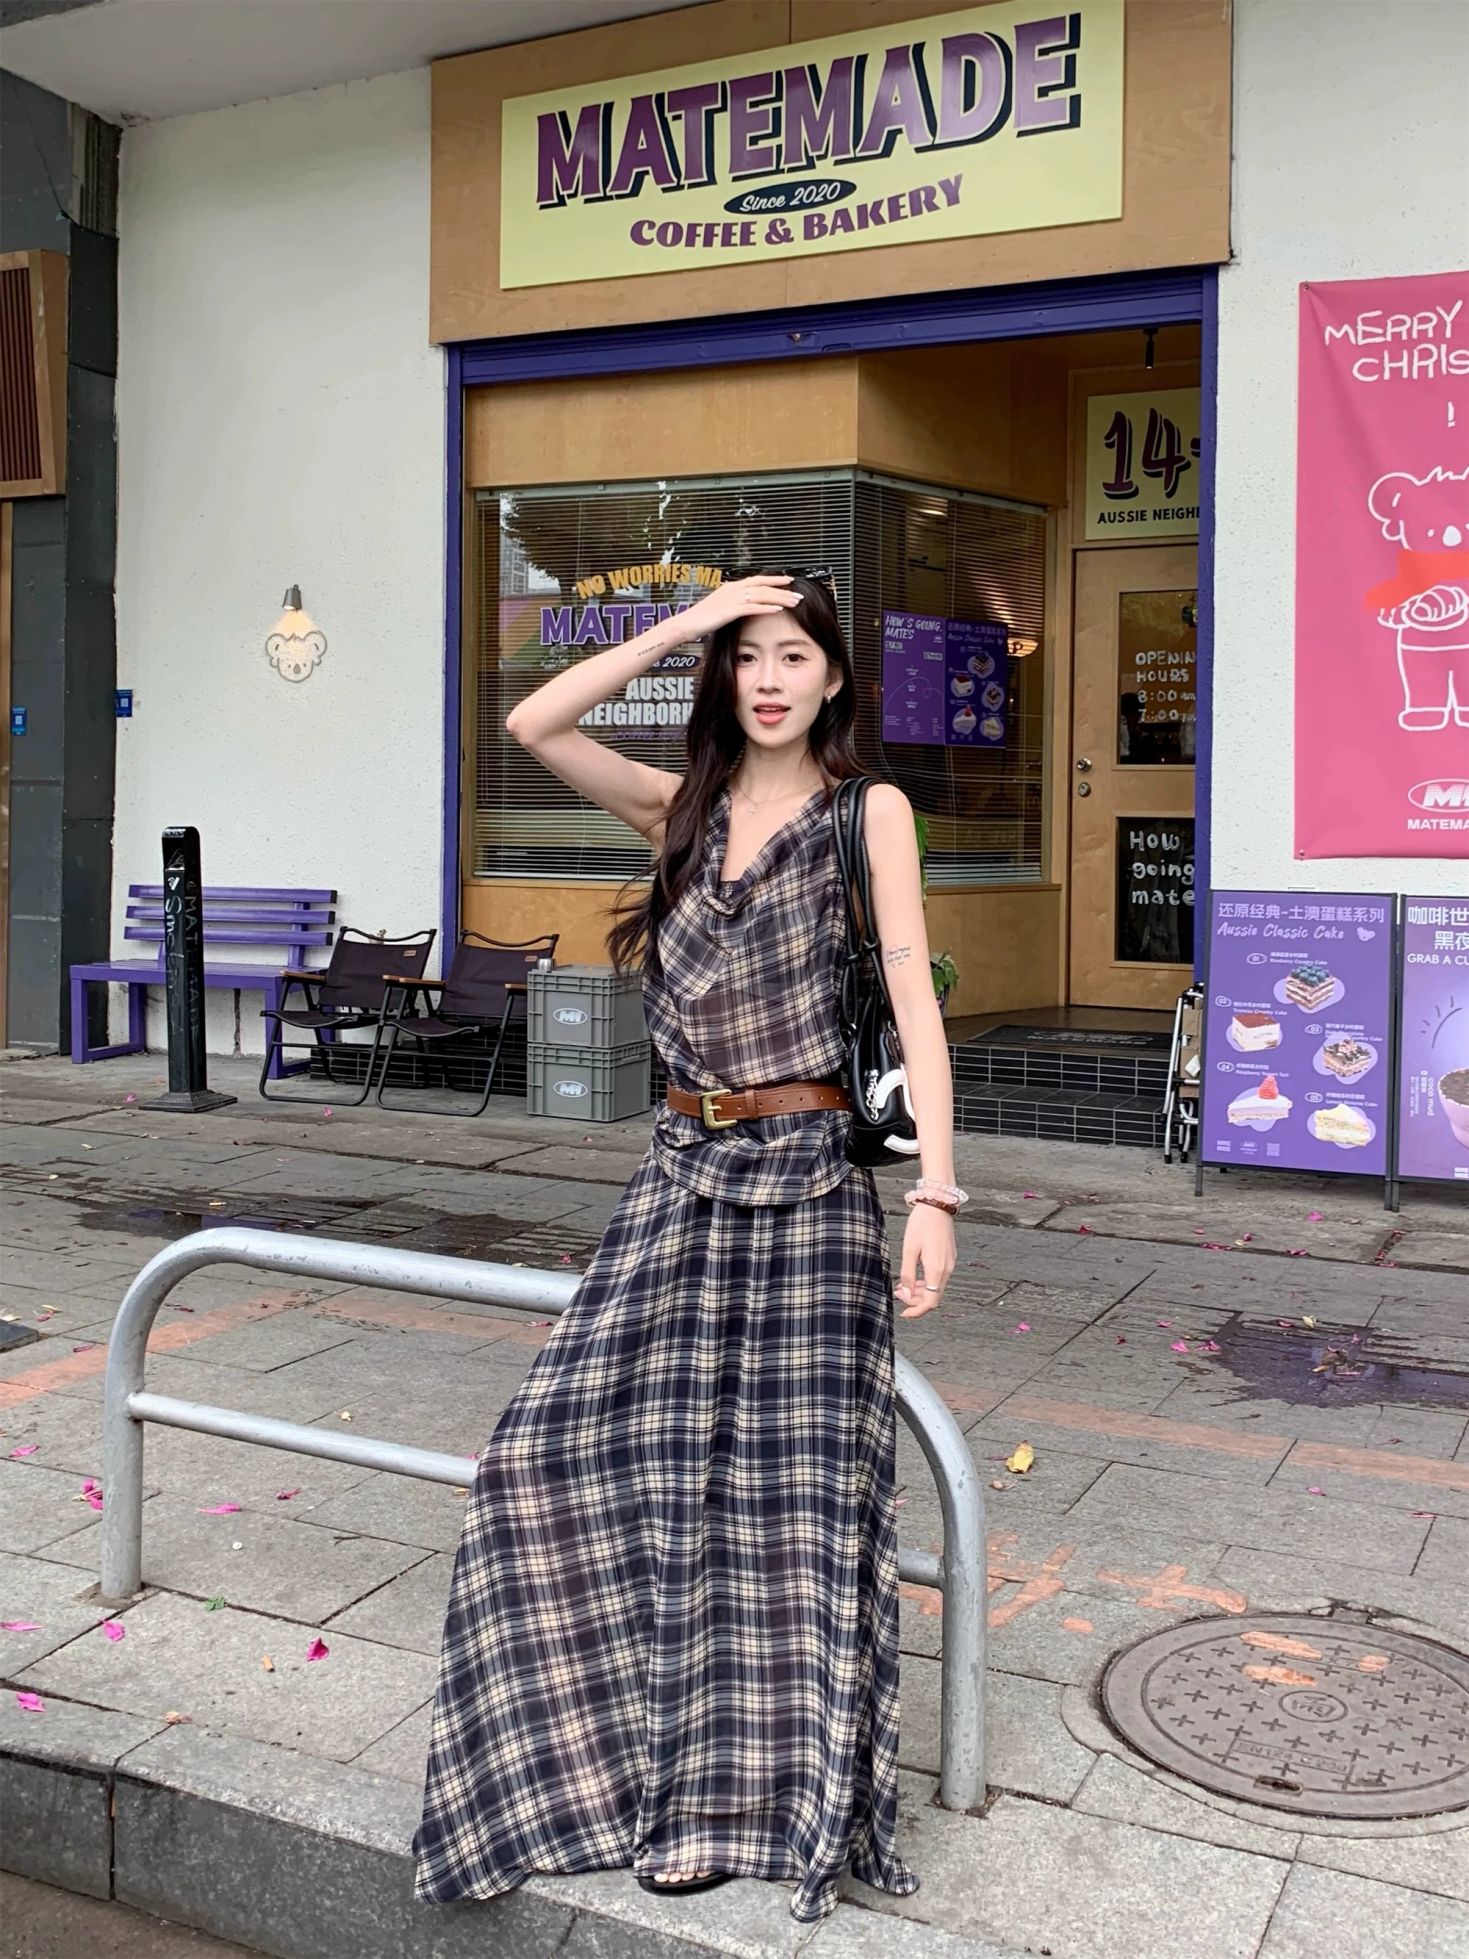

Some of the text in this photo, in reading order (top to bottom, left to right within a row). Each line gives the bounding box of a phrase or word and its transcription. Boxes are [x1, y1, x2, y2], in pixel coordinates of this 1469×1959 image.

[536, 13, 1082, 209] MATEMADE
[739, 181, 841, 212] Since 2020
[630, 174, 963, 248] COFFEE & BAKERY
[1324, 300, 1463, 346] MERRY
[1097, 510, 1147, 524] AUSSIE
[576, 575, 606, 599] NO
[607, 563, 691, 590] WORRIES
[662, 656, 696, 668] 2020
[1136, 668, 1189, 683] HOURS
[625, 677, 695, 700] AUSSIE
[1132, 859, 1195, 885] going
[1216, 921, 1345, 939] Aussie Classic Cake
[1407, 953, 1440, 964] GRAB
[1442, 955, 1452, 965] A
